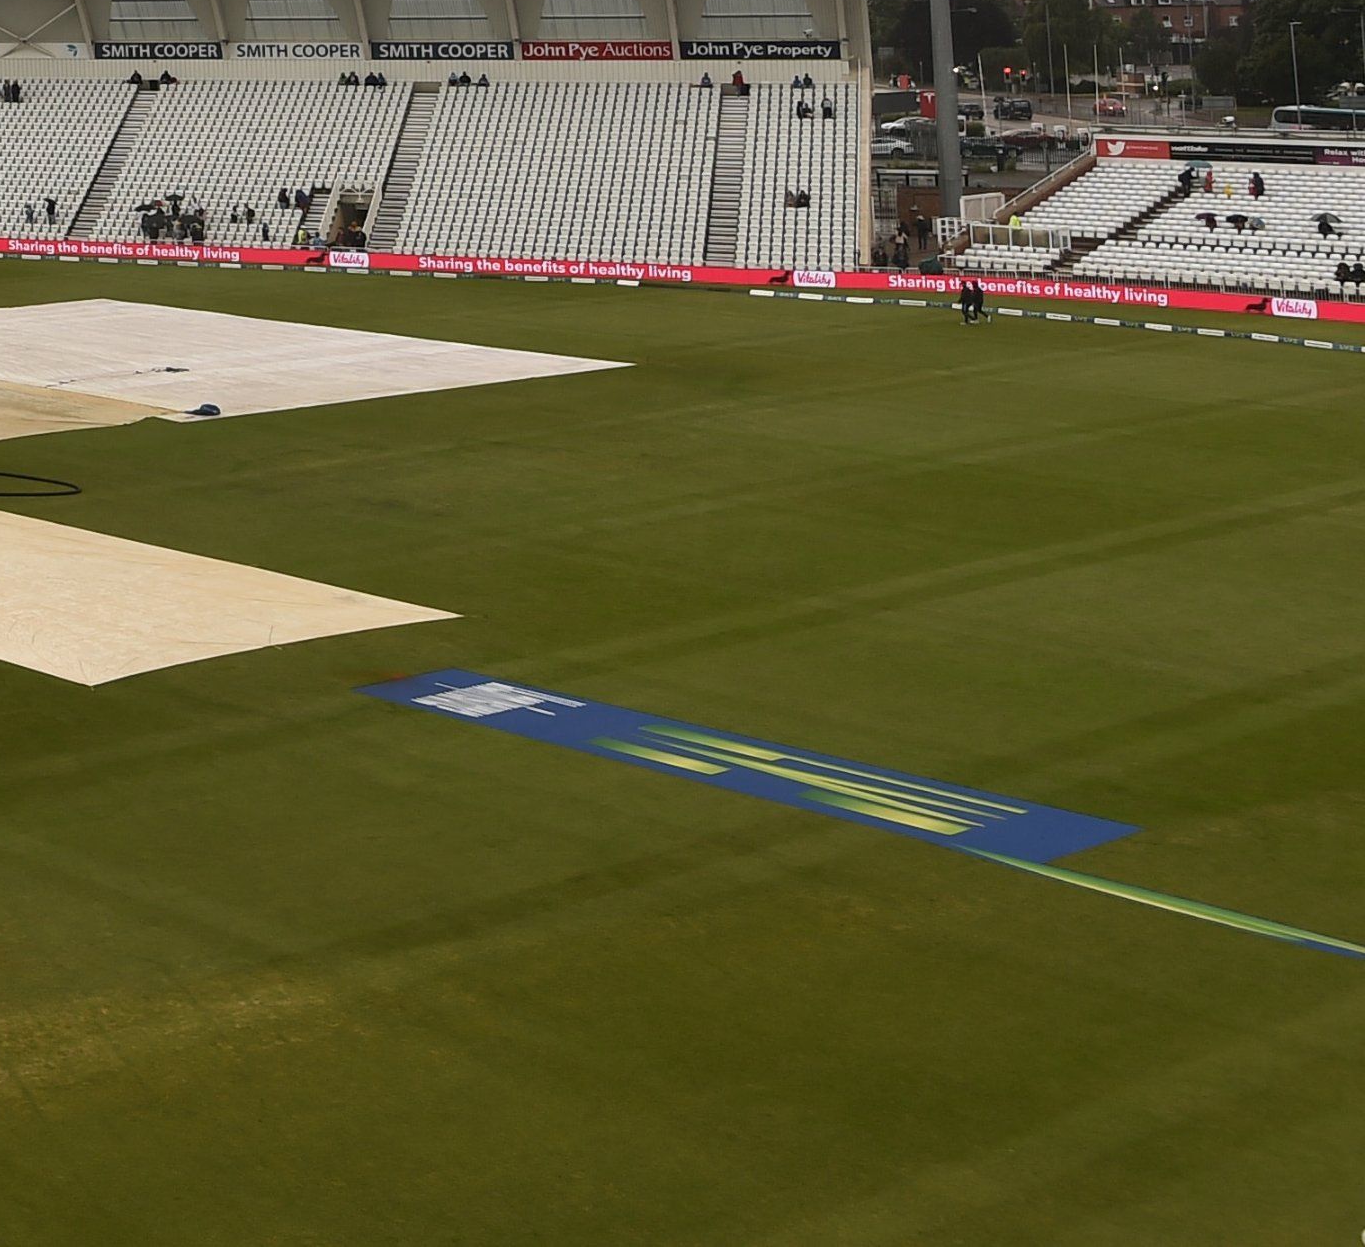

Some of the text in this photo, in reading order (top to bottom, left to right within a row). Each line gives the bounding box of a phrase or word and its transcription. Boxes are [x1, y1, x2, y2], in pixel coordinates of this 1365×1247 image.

[101, 44, 218, 57] SMITH COOPER
[237, 44, 360, 58] SMITH COOPER
[379, 44, 508, 58] SMITH COOPER
[524, 43, 670, 61] John Pye Auctions
[688, 42, 832, 59] John Pye Property
[8, 240, 239, 261] Sharing the benefits of healthy living
[419, 257, 691, 281] Sharing the benefits of healthy living
[797, 272, 832, 287] Vitality
[889, 275, 947, 292] Sharing
[978, 278, 1040, 295] benefits
[1045, 282, 1061, 296] of
[1065, 285, 1121, 302] healthy
[1125, 287, 1168, 307] living
[1276, 300, 1312, 316] Vitality
